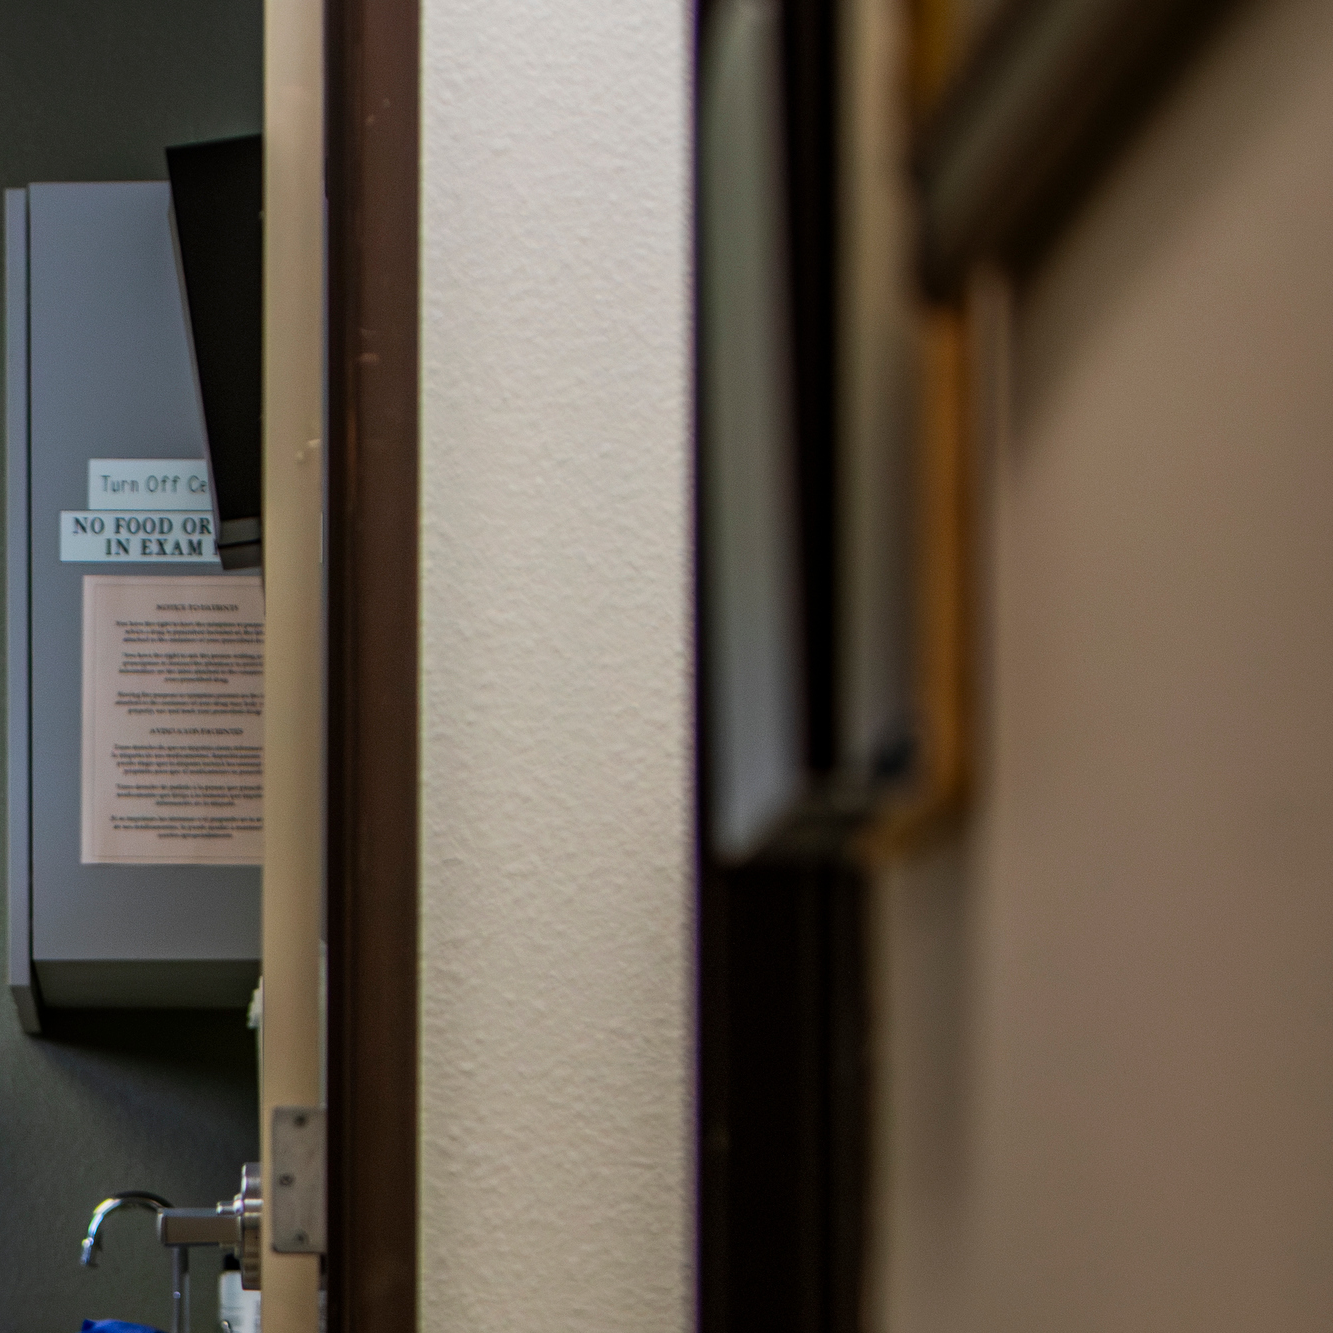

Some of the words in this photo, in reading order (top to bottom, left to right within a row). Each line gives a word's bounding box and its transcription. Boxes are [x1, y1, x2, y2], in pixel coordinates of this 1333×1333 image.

[101, 475, 139, 493] Turn
[146, 475, 181, 493] Off
[73, 517, 105, 534] NO
[114, 517, 173, 534] FOOD
[182, 517, 212, 535] OR
[105, 538, 131, 555] IN
[140, 538, 203, 555] EXAM
